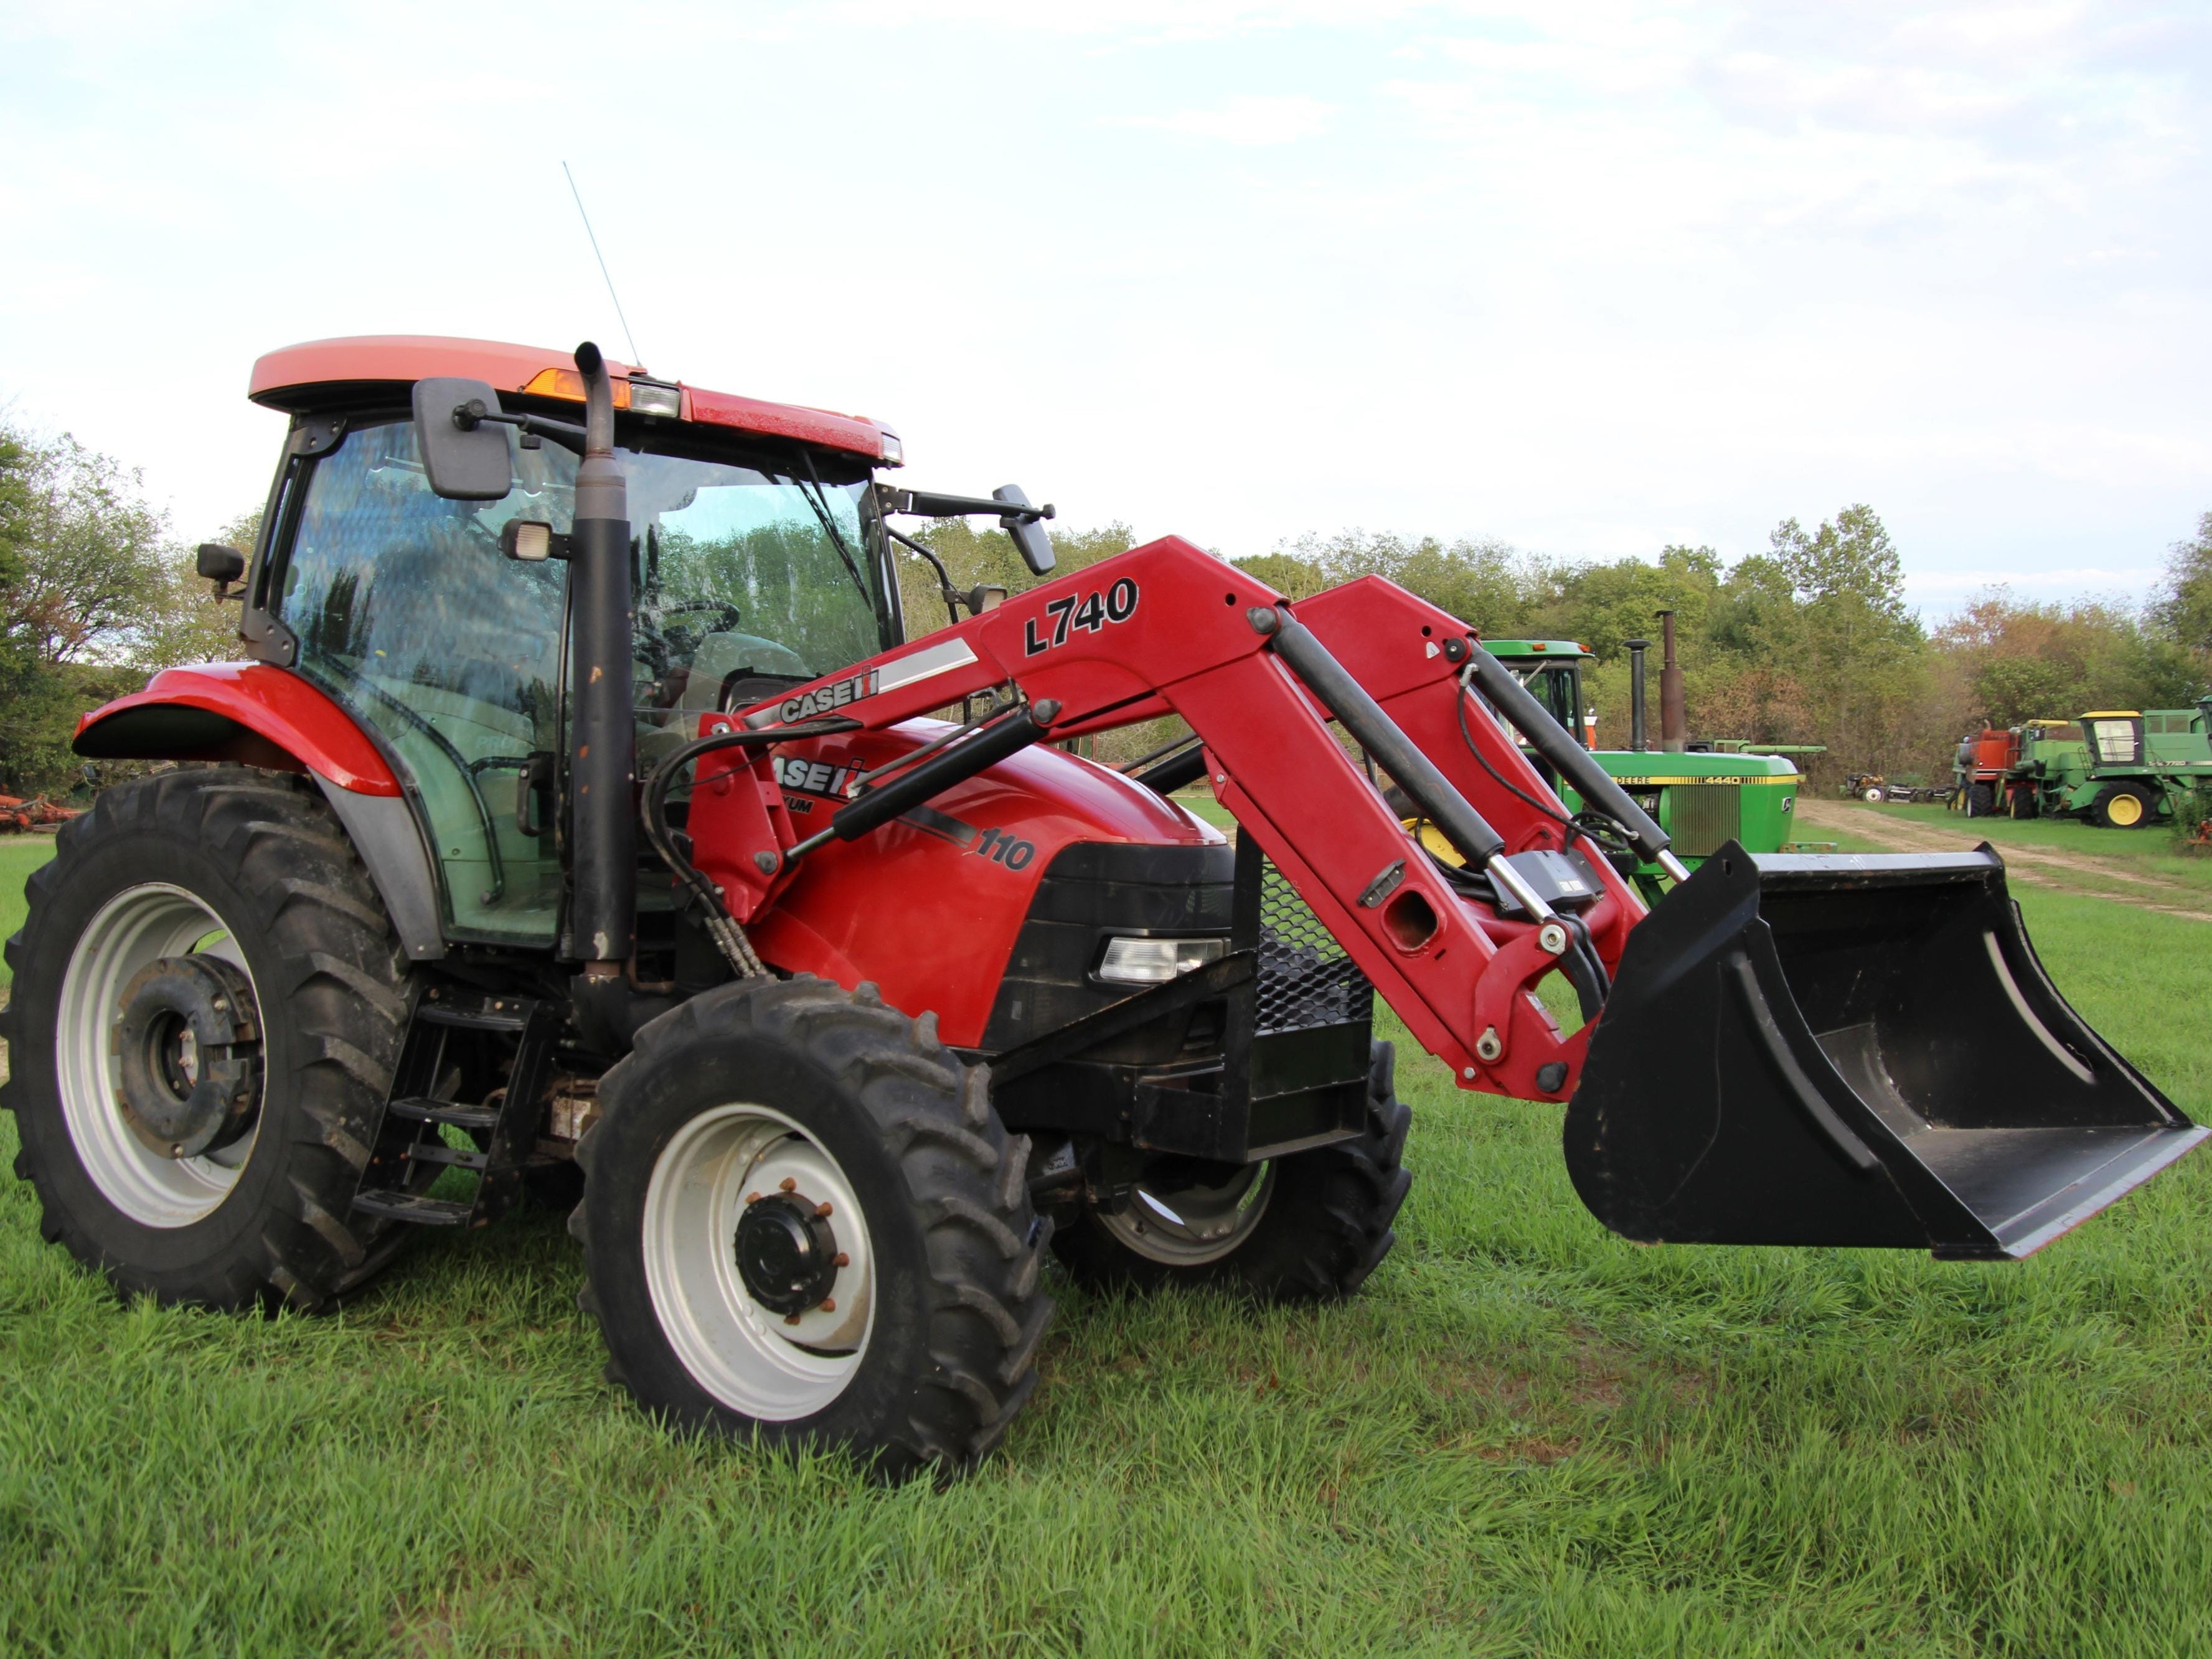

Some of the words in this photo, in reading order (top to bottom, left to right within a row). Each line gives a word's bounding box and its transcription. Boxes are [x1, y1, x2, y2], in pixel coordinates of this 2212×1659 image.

[1025, 576, 1139, 658] L740
[780, 680, 853, 724] CASE
[1617, 776, 1650, 784] DEERE
[1705, 776, 1741, 784] 4440
[976, 826, 1035, 872] 110
